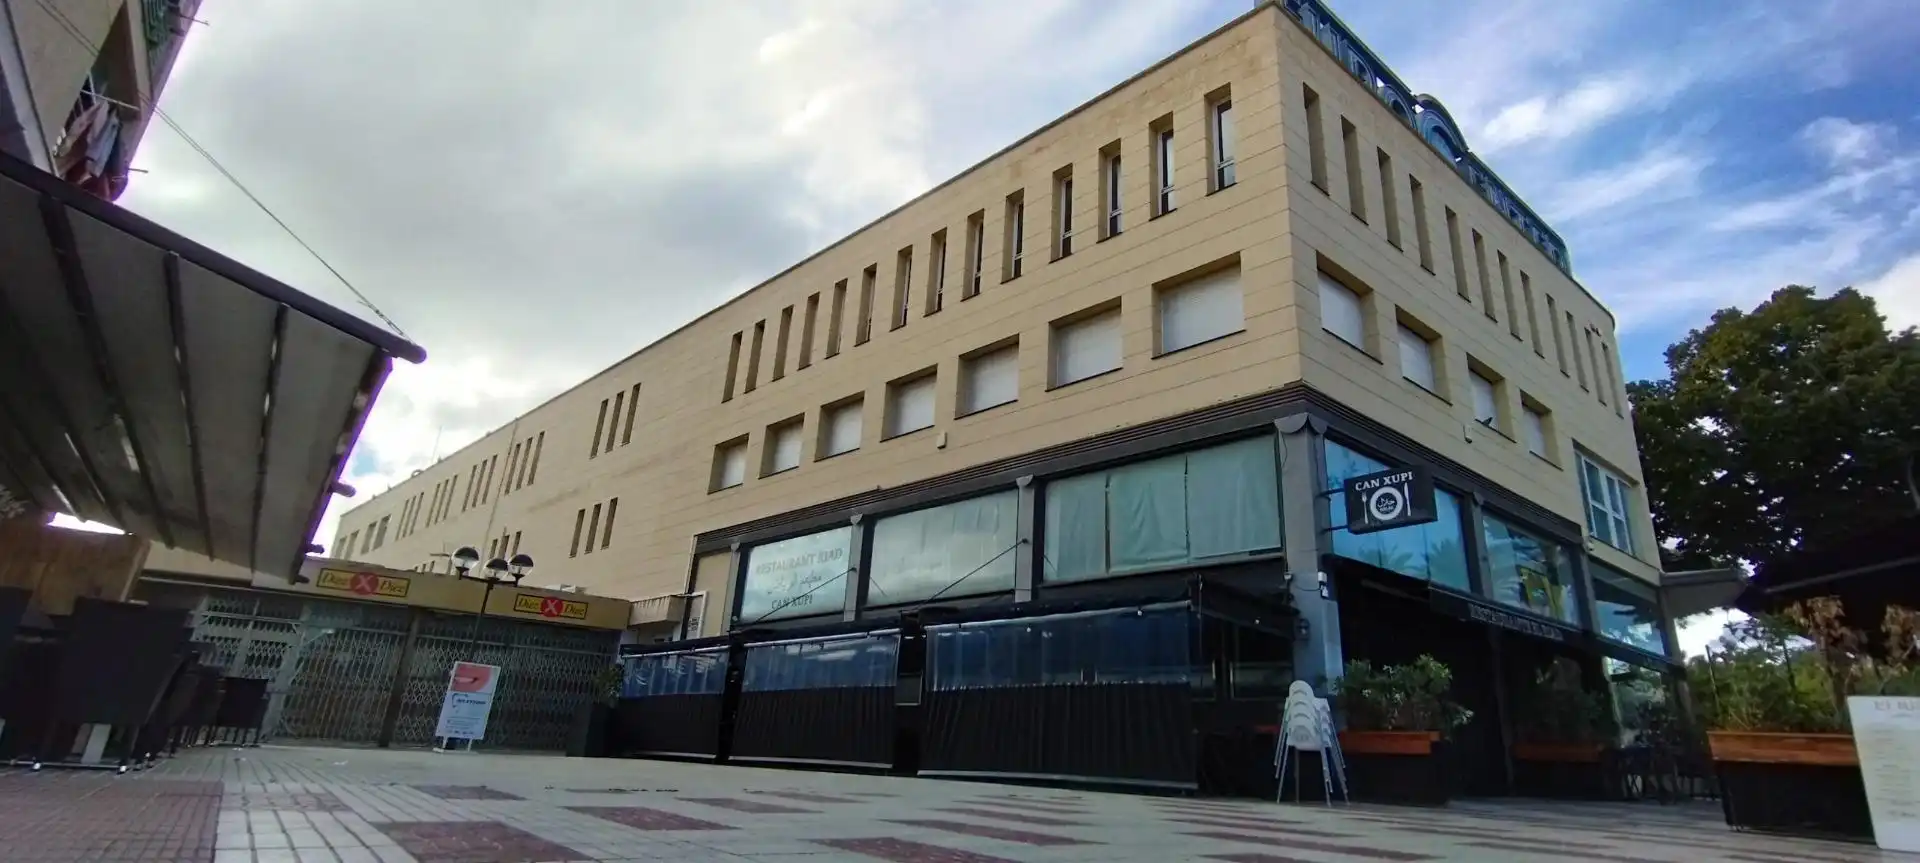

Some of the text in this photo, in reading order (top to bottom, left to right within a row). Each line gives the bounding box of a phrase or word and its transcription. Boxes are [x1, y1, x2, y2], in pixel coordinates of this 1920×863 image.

[1355, 471, 1413, 491] CAN XUPI
[354, 574, 376, 594] X
[518, 596, 586, 617] Diez X Diez
[771, 598, 790, 611] CAN
